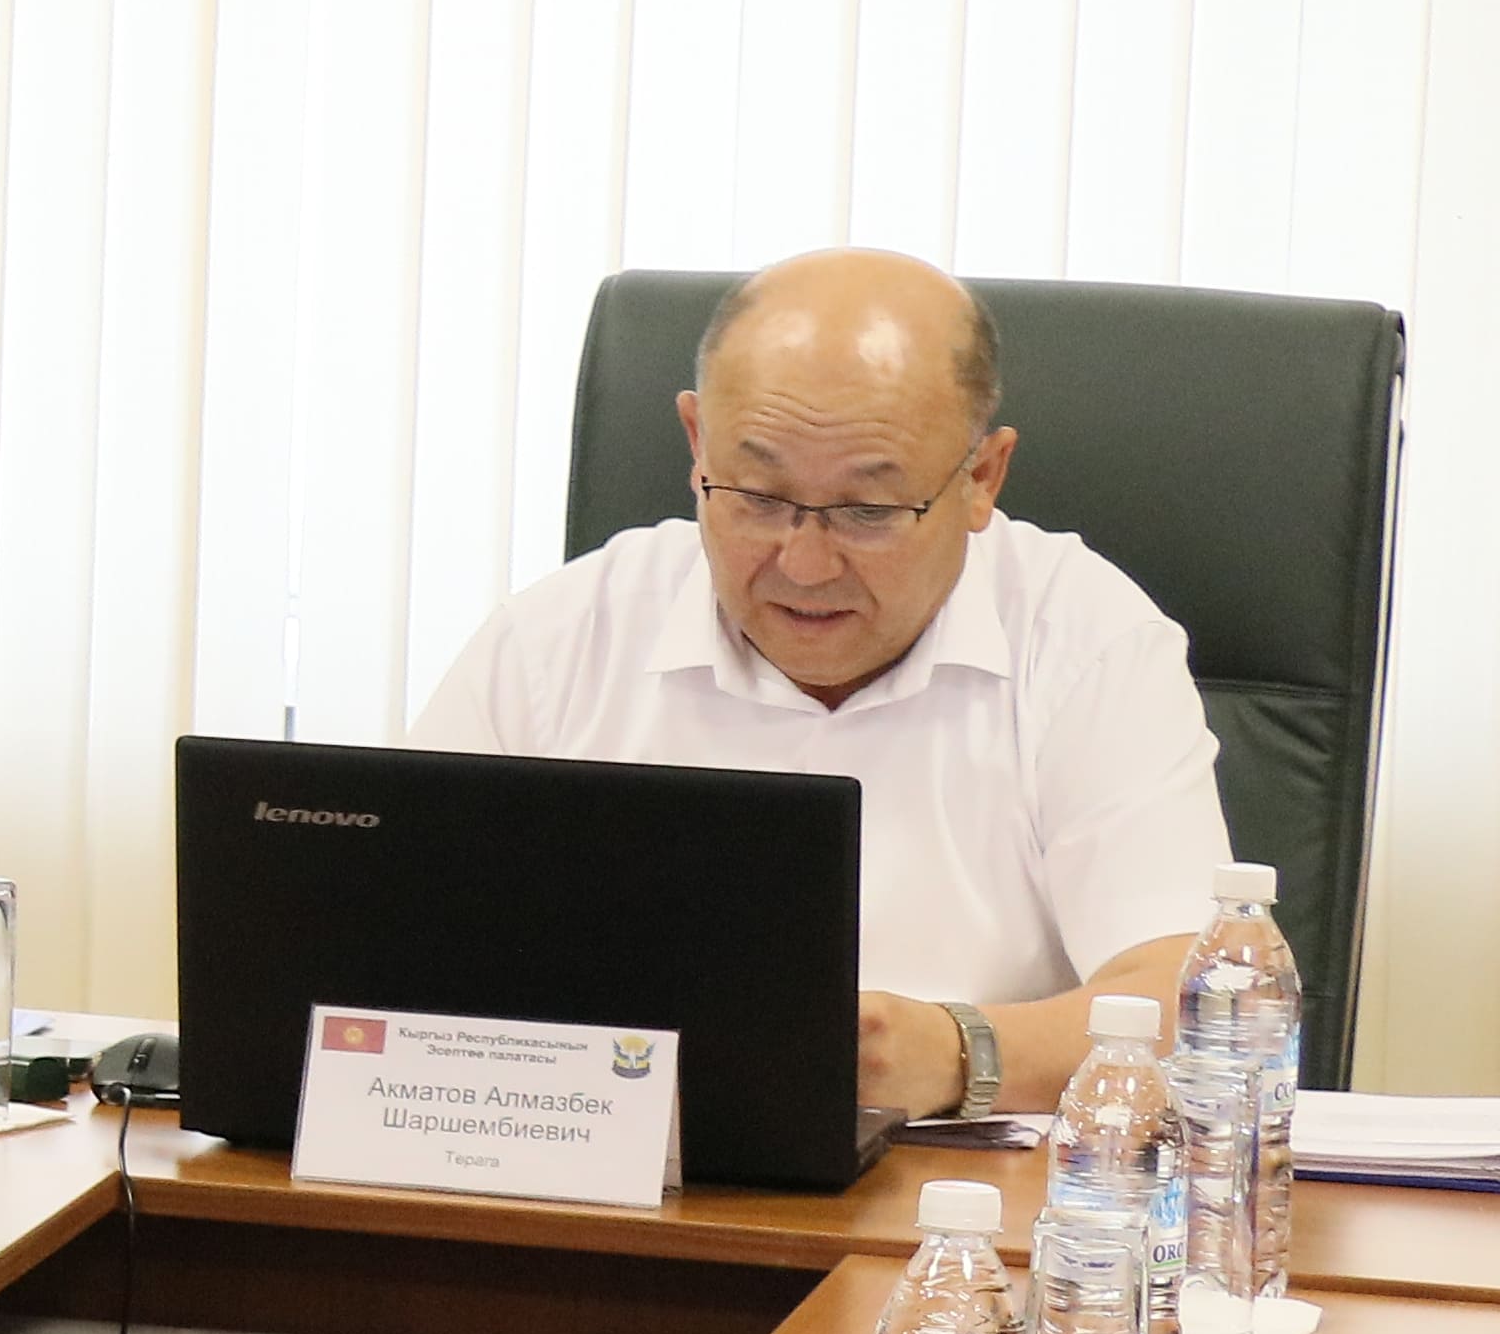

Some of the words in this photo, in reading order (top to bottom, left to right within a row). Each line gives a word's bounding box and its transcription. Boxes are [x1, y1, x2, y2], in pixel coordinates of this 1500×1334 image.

[252, 799, 381, 830] lenovo
[367, 1076, 477, 1105] Акматов
[483, 1085, 615, 1116] Алмазбек
[382, 1106, 592, 1143] Шаршембиевич
